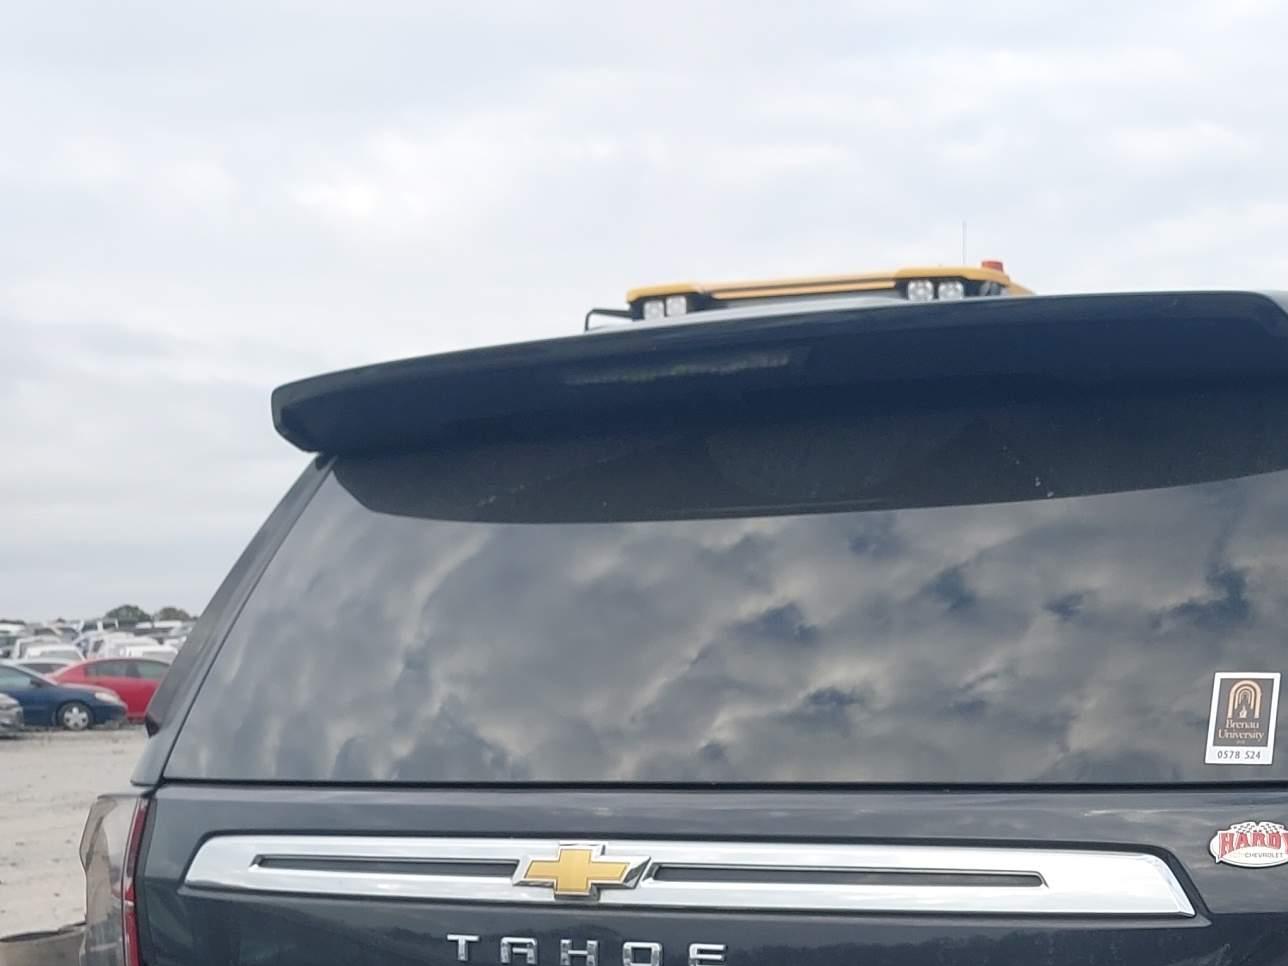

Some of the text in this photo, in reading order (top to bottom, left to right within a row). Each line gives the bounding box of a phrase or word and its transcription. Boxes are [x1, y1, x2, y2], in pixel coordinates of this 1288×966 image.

[1226, 719, 1259, 729] Brenau
[1218, 729, 1264, 742] University
[1217, 750, 1261, 760] 0578 524
